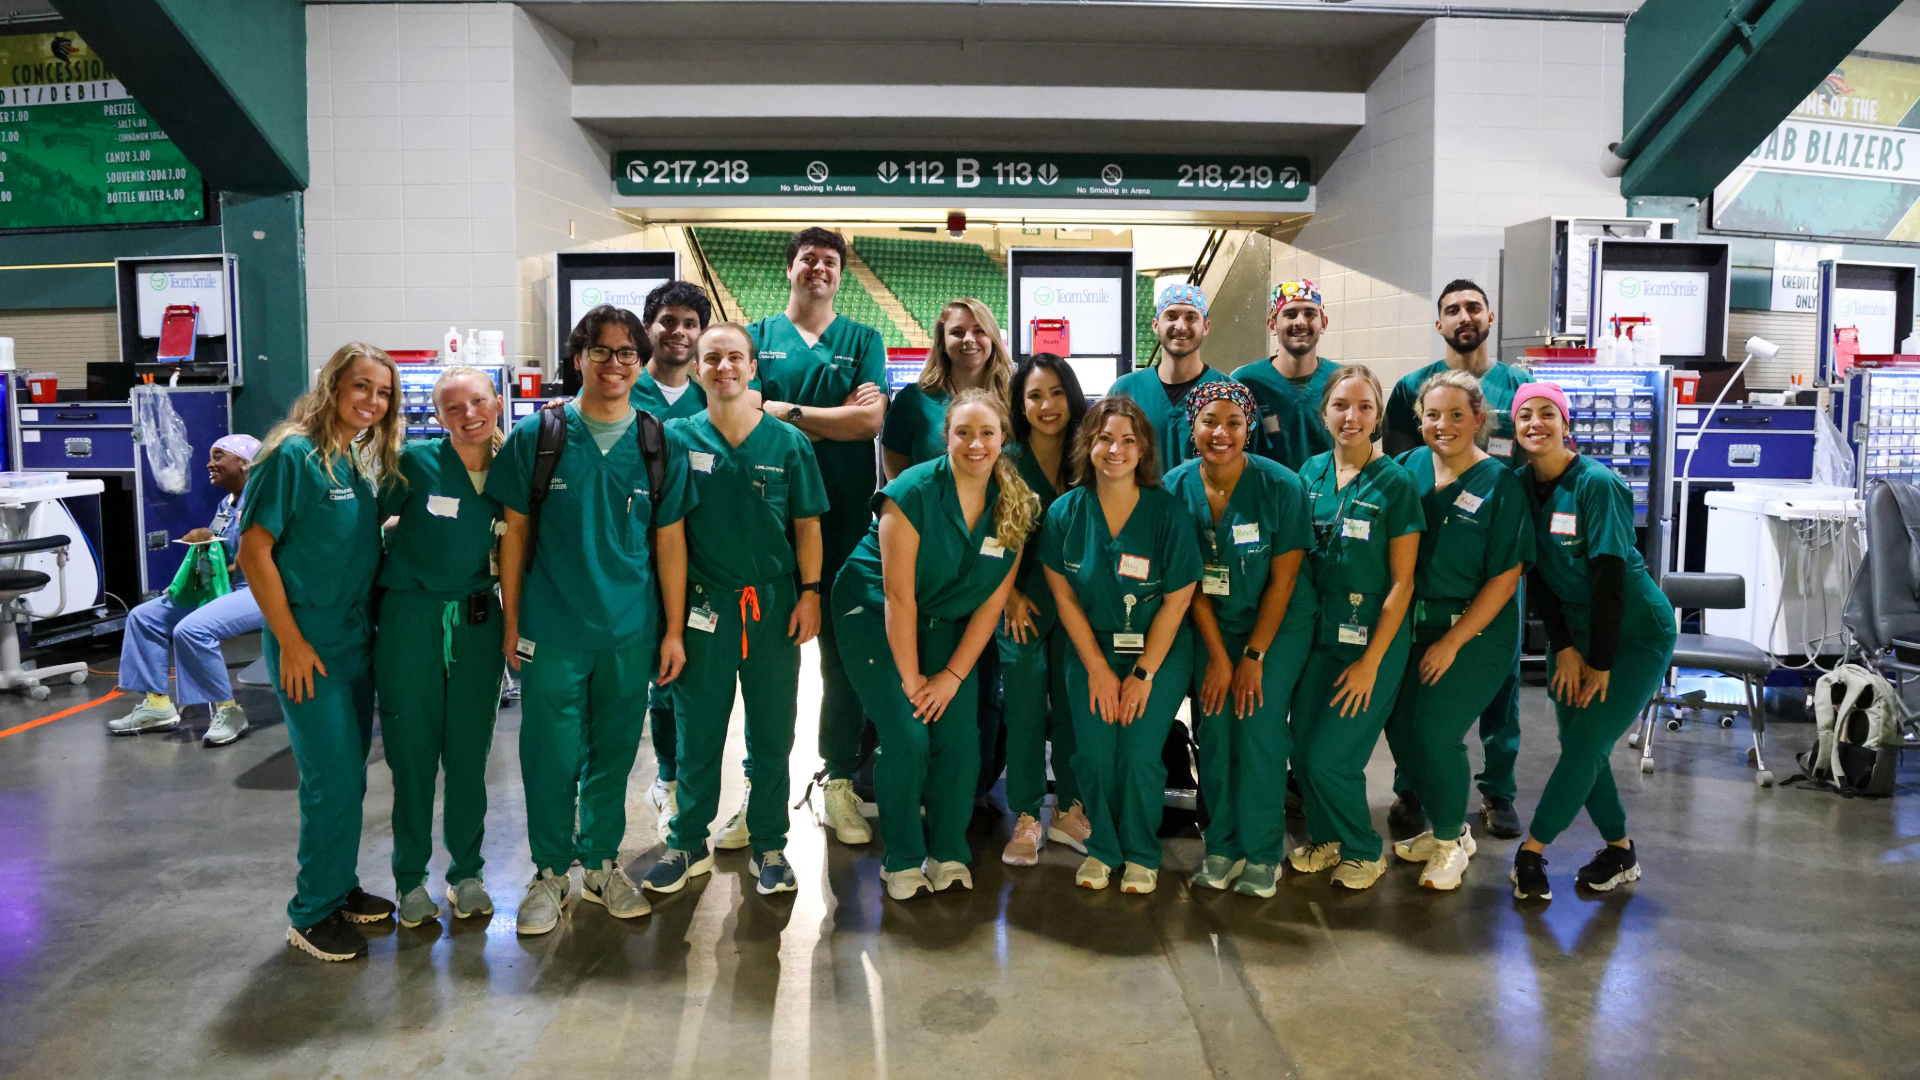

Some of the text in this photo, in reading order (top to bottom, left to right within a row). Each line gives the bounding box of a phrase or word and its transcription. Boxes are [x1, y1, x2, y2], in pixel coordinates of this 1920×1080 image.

[104, 104, 136, 116] PRETZEL
[1798, 94, 1878, 121] OME OF THE
[11, 111, 29, 122] 7.00
[1749, 124, 1906, 171] AB BLAZERS
[106, 150, 150, 163] CANDY 3.00
[106, 168, 186, 184] SOUVENIR SODA 7.00
[653, 160, 749, 187] 217,218
[905, 158, 1033, 188] 112 B 113
[1177, 164, 1273, 191] 218,219
[107, 188, 185, 204] BOTTLE WATER 4.00
[793, 184, 824, 193] Smoking
[1076, 186, 1087, 194] No
[1089, 187, 1119, 196] Smoking
[1121, 187, 1128, 195] in
[168, 273, 217, 289] TeamSmile
[1642, 280, 1698, 297] TeamSmile
[1782, 275, 1809, 289] CREDIT
[603, 290, 650, 306] TeamSmi
[1055, 287, 1110, 304] TeamSmile
[1796, 295, 1817, 309] ONLY
[1853, 300, 1889, 316] TeamSmile
